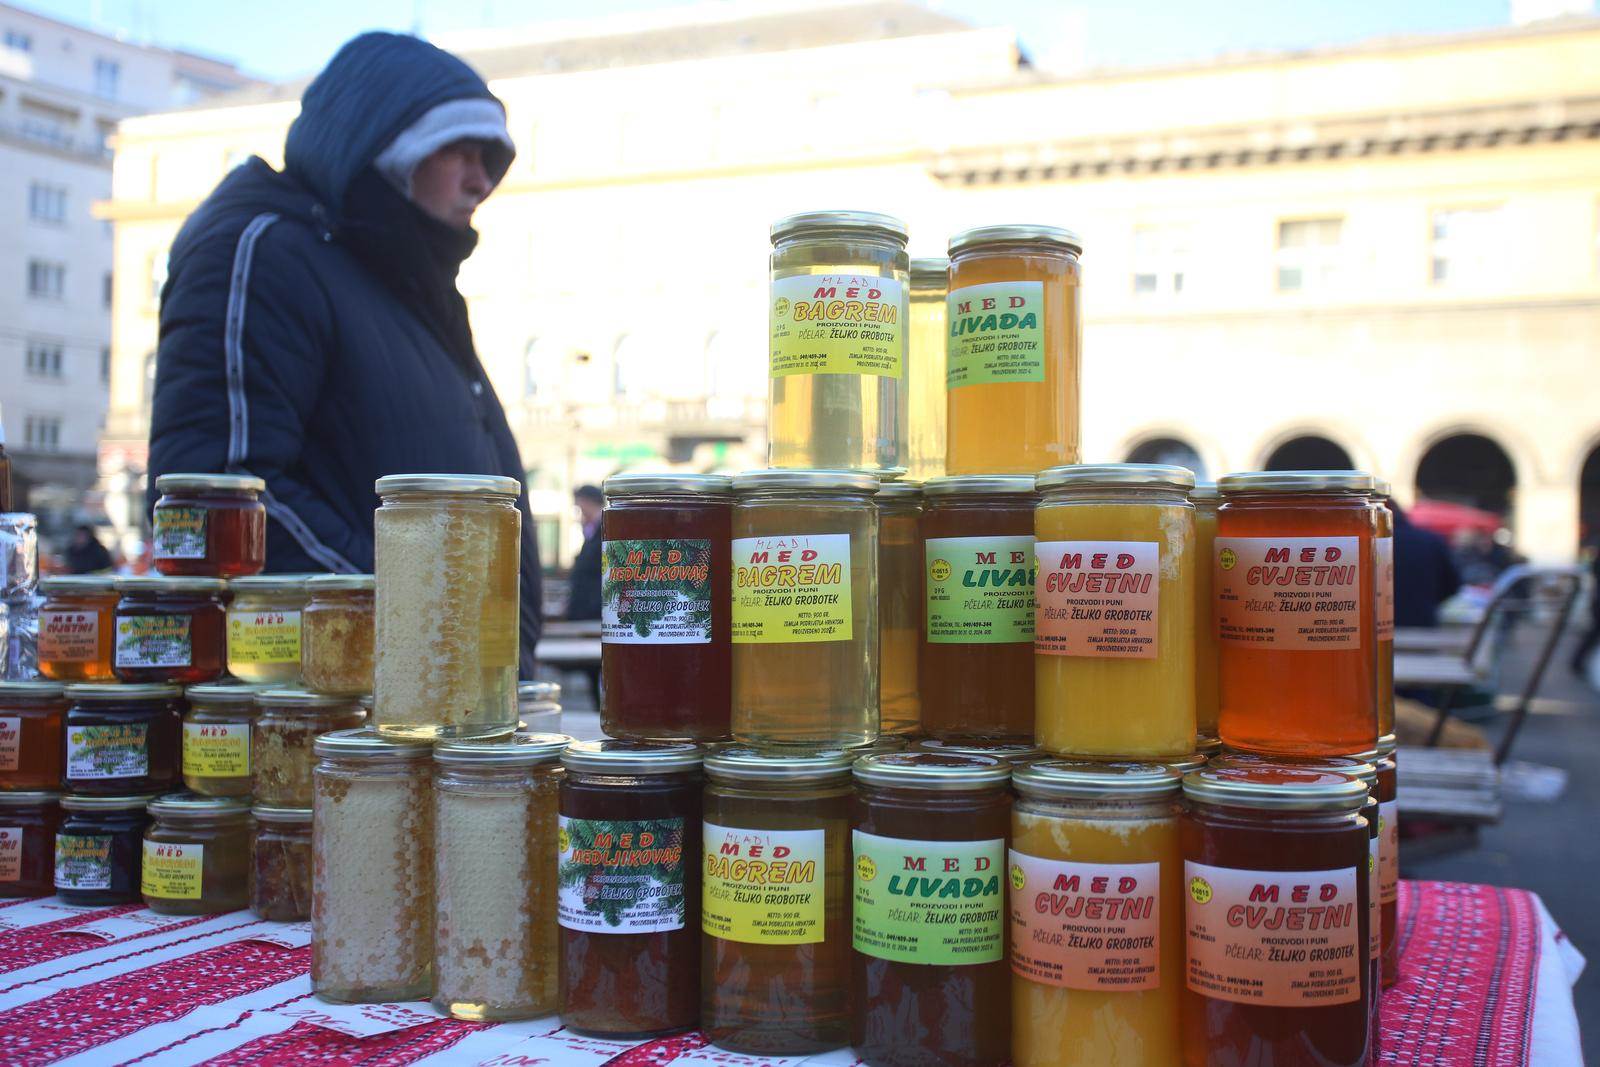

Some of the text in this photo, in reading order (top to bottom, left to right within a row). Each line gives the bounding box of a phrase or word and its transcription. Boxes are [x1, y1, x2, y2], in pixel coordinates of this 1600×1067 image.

[822, 277, 879, 288] MLADI
[814, 287, 881, 299] MED
[794, 301, 897, 324] BAGREM
[958, 297, 1025, 314] MED
[951, 313, 1036, 336] LIVADA
[830, 328, 858, 339] ŽELJKO
[861, 331, 894, 342] GROBOTEK
[971, 342, 1037, 353] ŽELJKO GROBOTEK
[756, 539, 809, 549] MLADI
[626, 550, 681, 565] MED
[751, 550, 817, 563] MED
[1060, 553, 1135, 569] MED
[1265, 548, 1341, 562] MED
[737, 563, 841, 587] BAGREM
[1247, 566, 1355, 586] CVJETNI
[1046, 573, 1152, 593] CVJETNI
[633, 601, 662, 611] ŽELJKO
[665, 600, 710, 611] GROBOTEK
[765, 595, 792, 606] ŽELJKO
[795, 594, 838, 605] GROBOTEK
[997, 599, 1024, 608] ŽELJKO
[1279, 599, 1311, 611] ŽELJKO
[1315, 601, 1356, 611] GROBOTEK
[255, 616, 285, 625] MED
[1071, 607, 1101, 619] ŽELJKO
[1105, 610, 1152, 620] GROBOTEK
[201, 727, 228, 737] MED
[594, 832, 654, 848] MED
[726, 832, 770, 845] MLADI
[157, 848, 183, 858] MED
[720, 843, 790, 858] MED
[707, 854, 815, 884] BAGREM
[904, 856, 991, 872] MED
[636, 884, 682, 898] GROBOTEK
[722, 882, 761, 890] PROIZVODI
[888, 875, 998, 898] LIVADA
[1054, 874, 1137, 894] MED
[734, 891, 811, 905] ŽELJKO GROBOTEK
[1249, 883, 1338, 903] MED
[1035, 892, 1153, 920] CVJETNI
[925, 911, 956, 924] ŽELJKO
[960, 911, 999, 923] GROBOTEK
[1227, 903, 1352, 930] CVJETNI
[1062, 924, 1101, 934] PROIZVODI
[1068, 934, 1102, 949] ŽELJKO
[1106, 936, 1155, 950] GROBOTEK
[1261, 937, 1304, 945] PROIZVODI
[1225, 943, 1354, 962] PČELAR: ŽELJKO GROBOTEK
